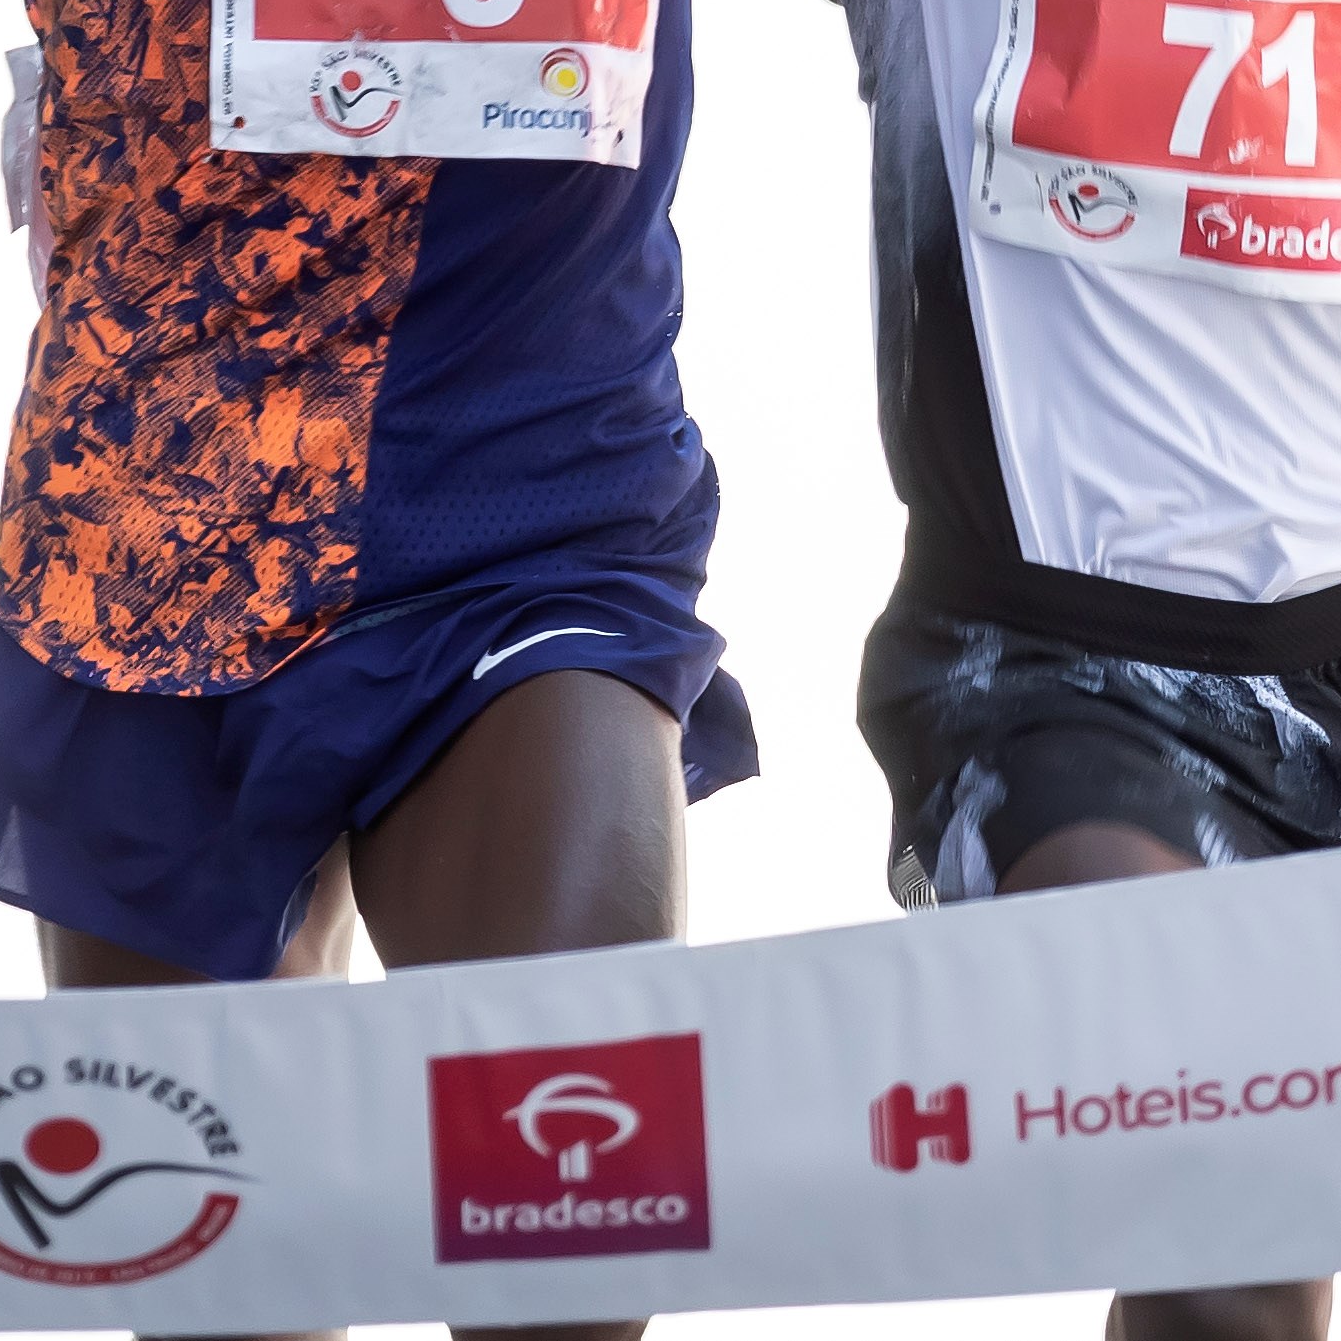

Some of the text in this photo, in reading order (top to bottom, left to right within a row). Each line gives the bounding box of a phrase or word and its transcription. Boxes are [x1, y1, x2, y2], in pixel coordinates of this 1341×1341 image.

[1163, 2, 1317, 167] 71
[482, 101, 611, 138] Piracanj
[64, 1057, 238, 1156] SILVESTRE
[461, 1195, 690, 1235] bradesco
